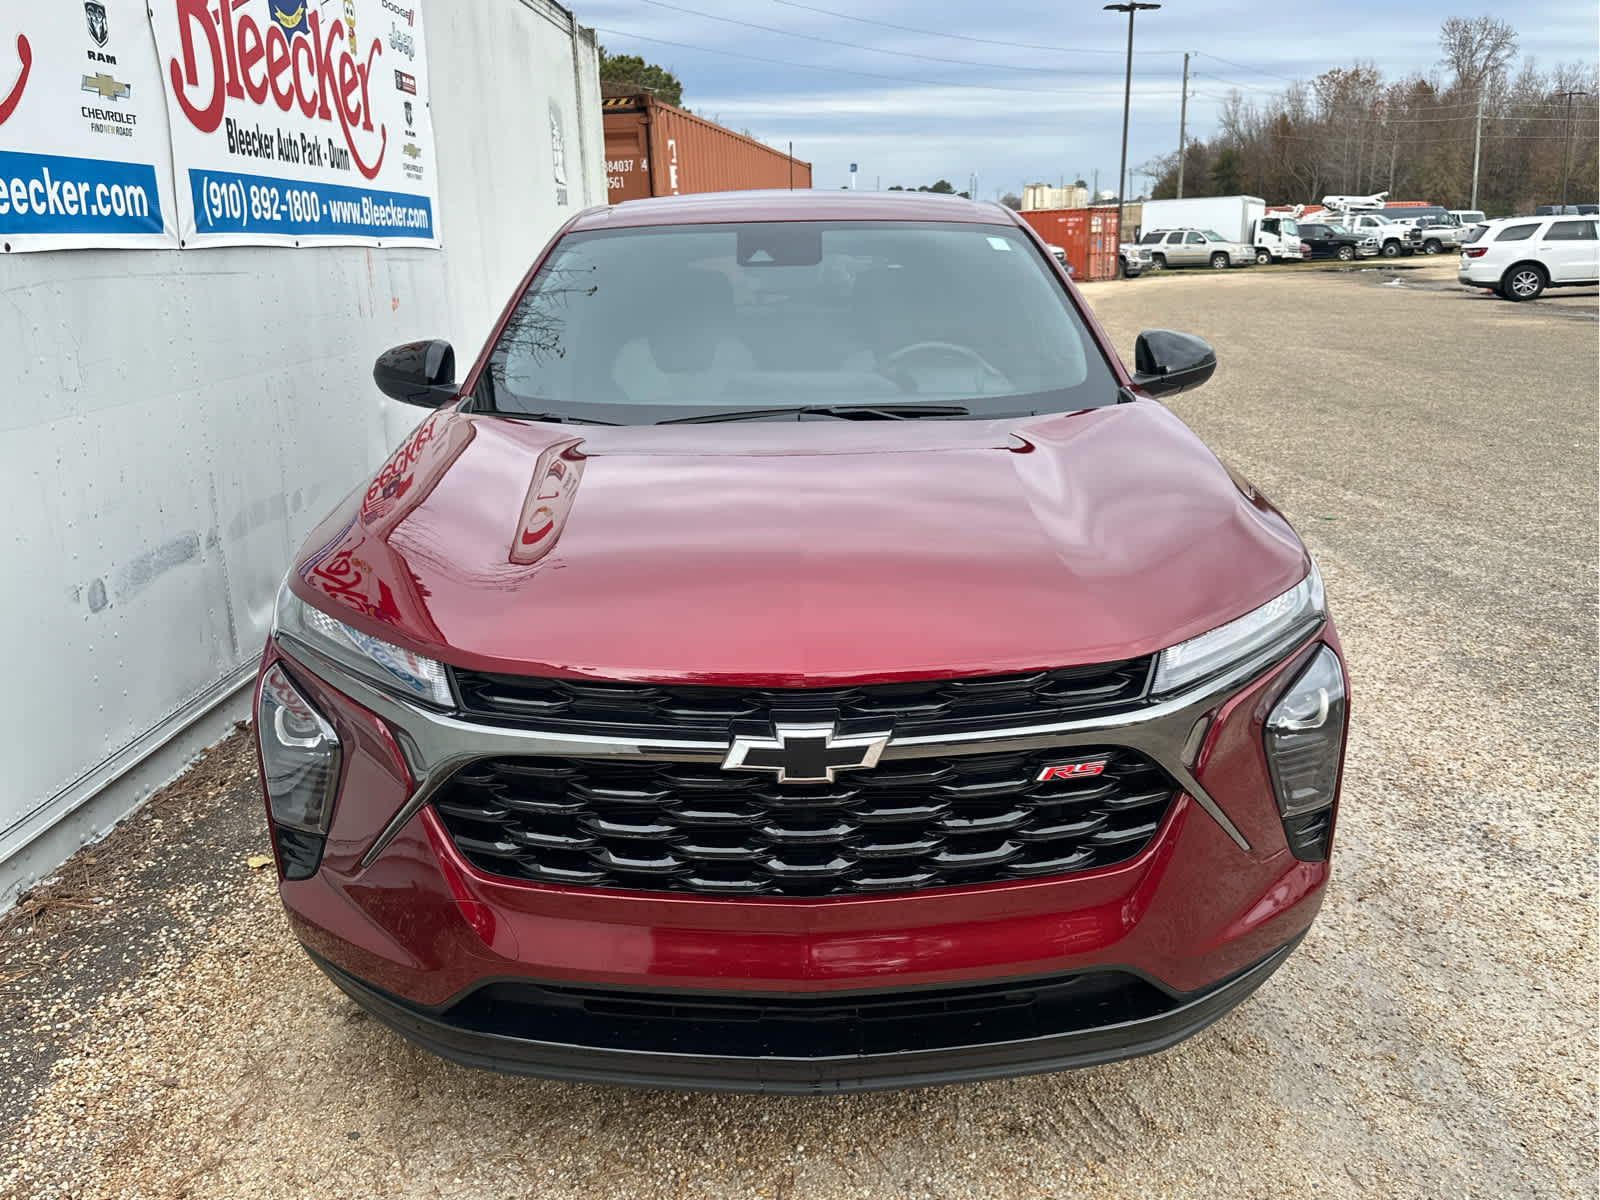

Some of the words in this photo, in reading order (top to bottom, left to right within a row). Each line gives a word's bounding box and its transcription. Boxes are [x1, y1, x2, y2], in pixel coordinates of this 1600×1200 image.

[87, 50, 117, 65] RAM
[81, 106, 137, 125] CHEVROLET
[225, 117, 274, 160] Bleecker
[277, 127, 300, 164] Auto
[300, 132, 323, 167] Park
[328, 138, 350, 171] Dunn
[203, 176, 248, 227] (910)
[250, 185, 320, 222] 892-1800
[329, 196, 429, 229] www.Bleecker.com
[1036, 760, 1107, 781] RS
